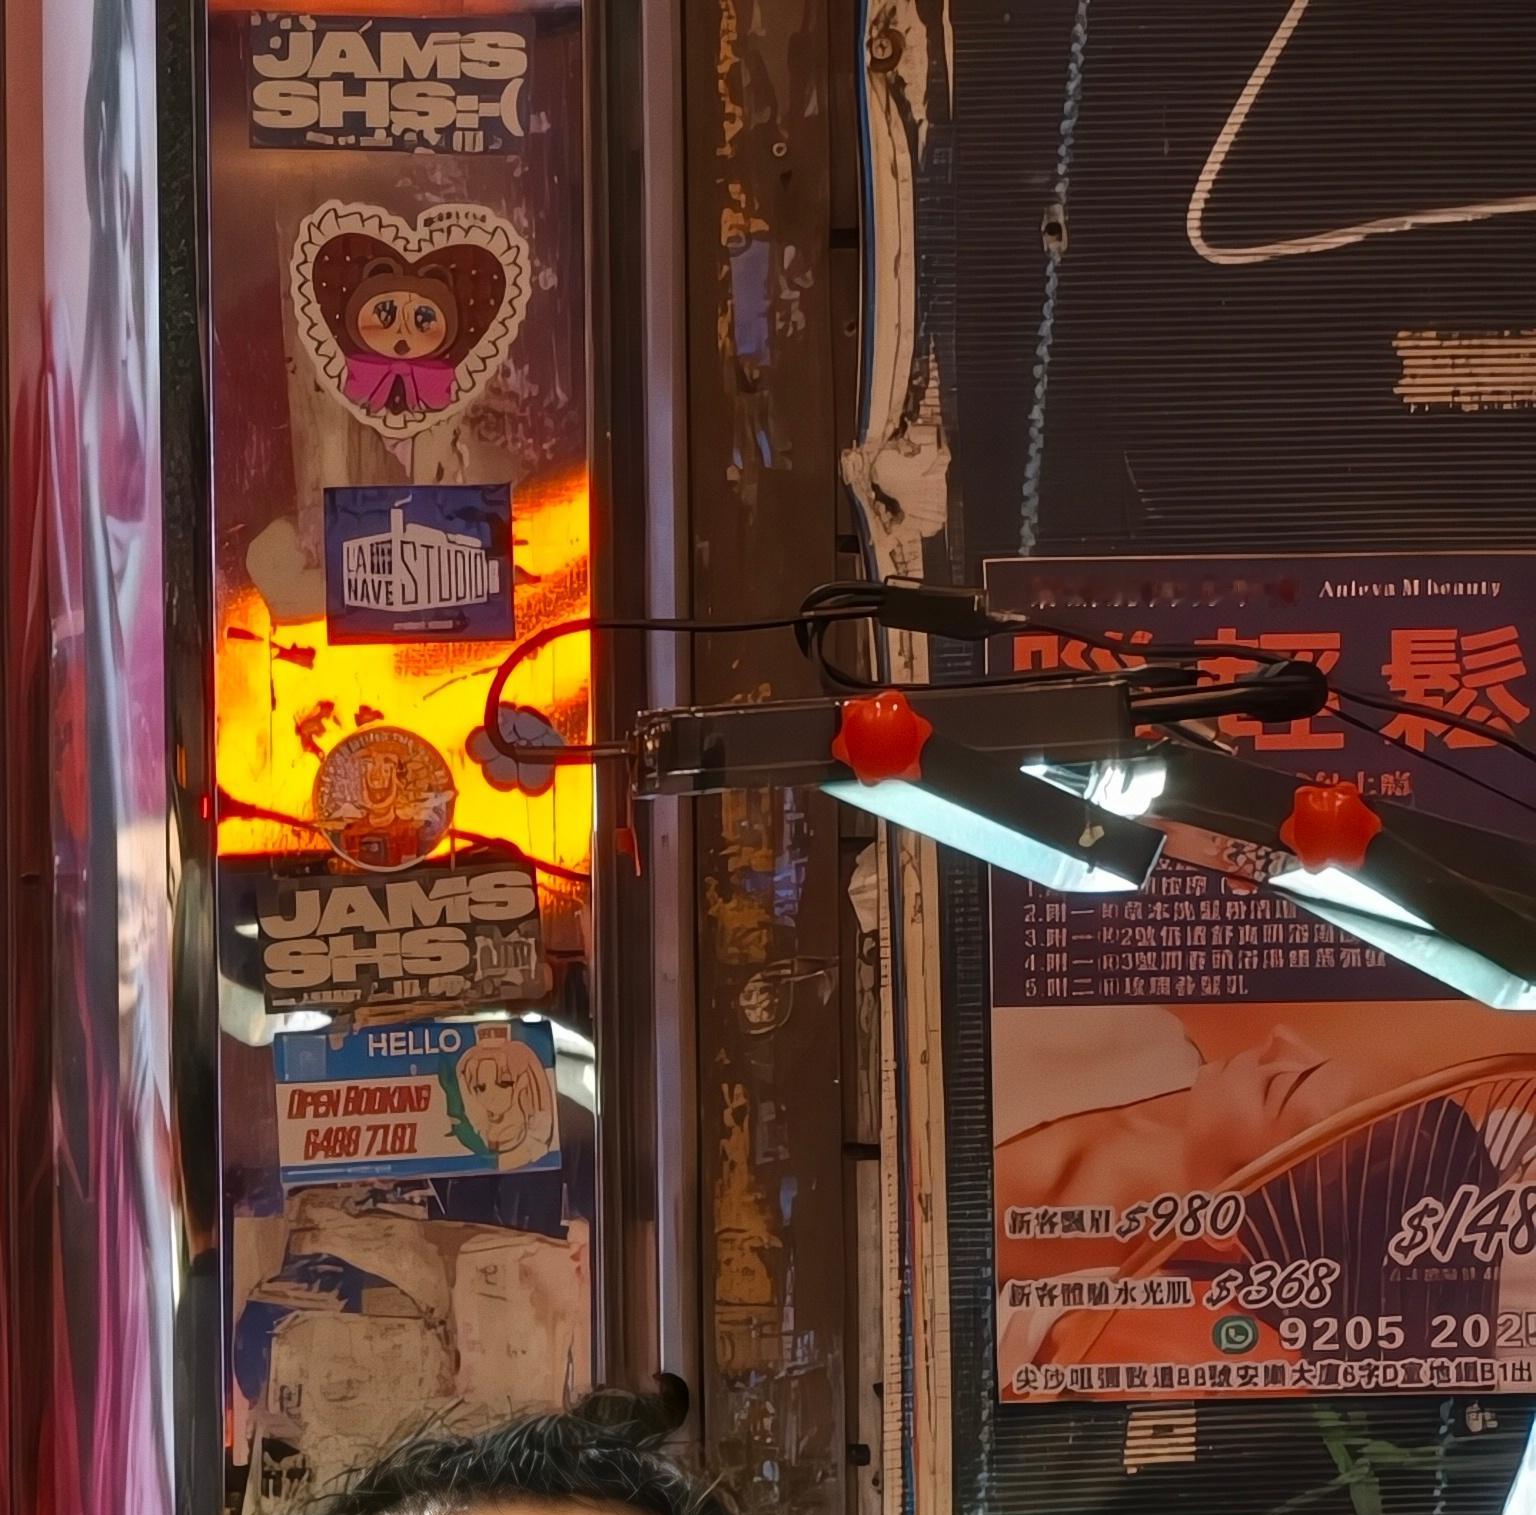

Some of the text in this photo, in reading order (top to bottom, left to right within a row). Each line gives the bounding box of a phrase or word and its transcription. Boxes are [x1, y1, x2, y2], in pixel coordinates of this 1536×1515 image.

[252, 31, 527, 79] JAMS
[346, 540, 487, 605] LA STUDIO
[348, 578, 394, 606] NAVE
[260, 870, 536, 938] JAMS
[264, 926, 469, 988] SHS
[368, 1028, 461, 1057] HELLO
[287, 1084, 431, 1119] OPEN BOOKING
[1116, 1194, 1243, 1238] $980
[1207, 1260, 1338, 1308] $368
[1279, 1314, 1405, 1351] 9205
